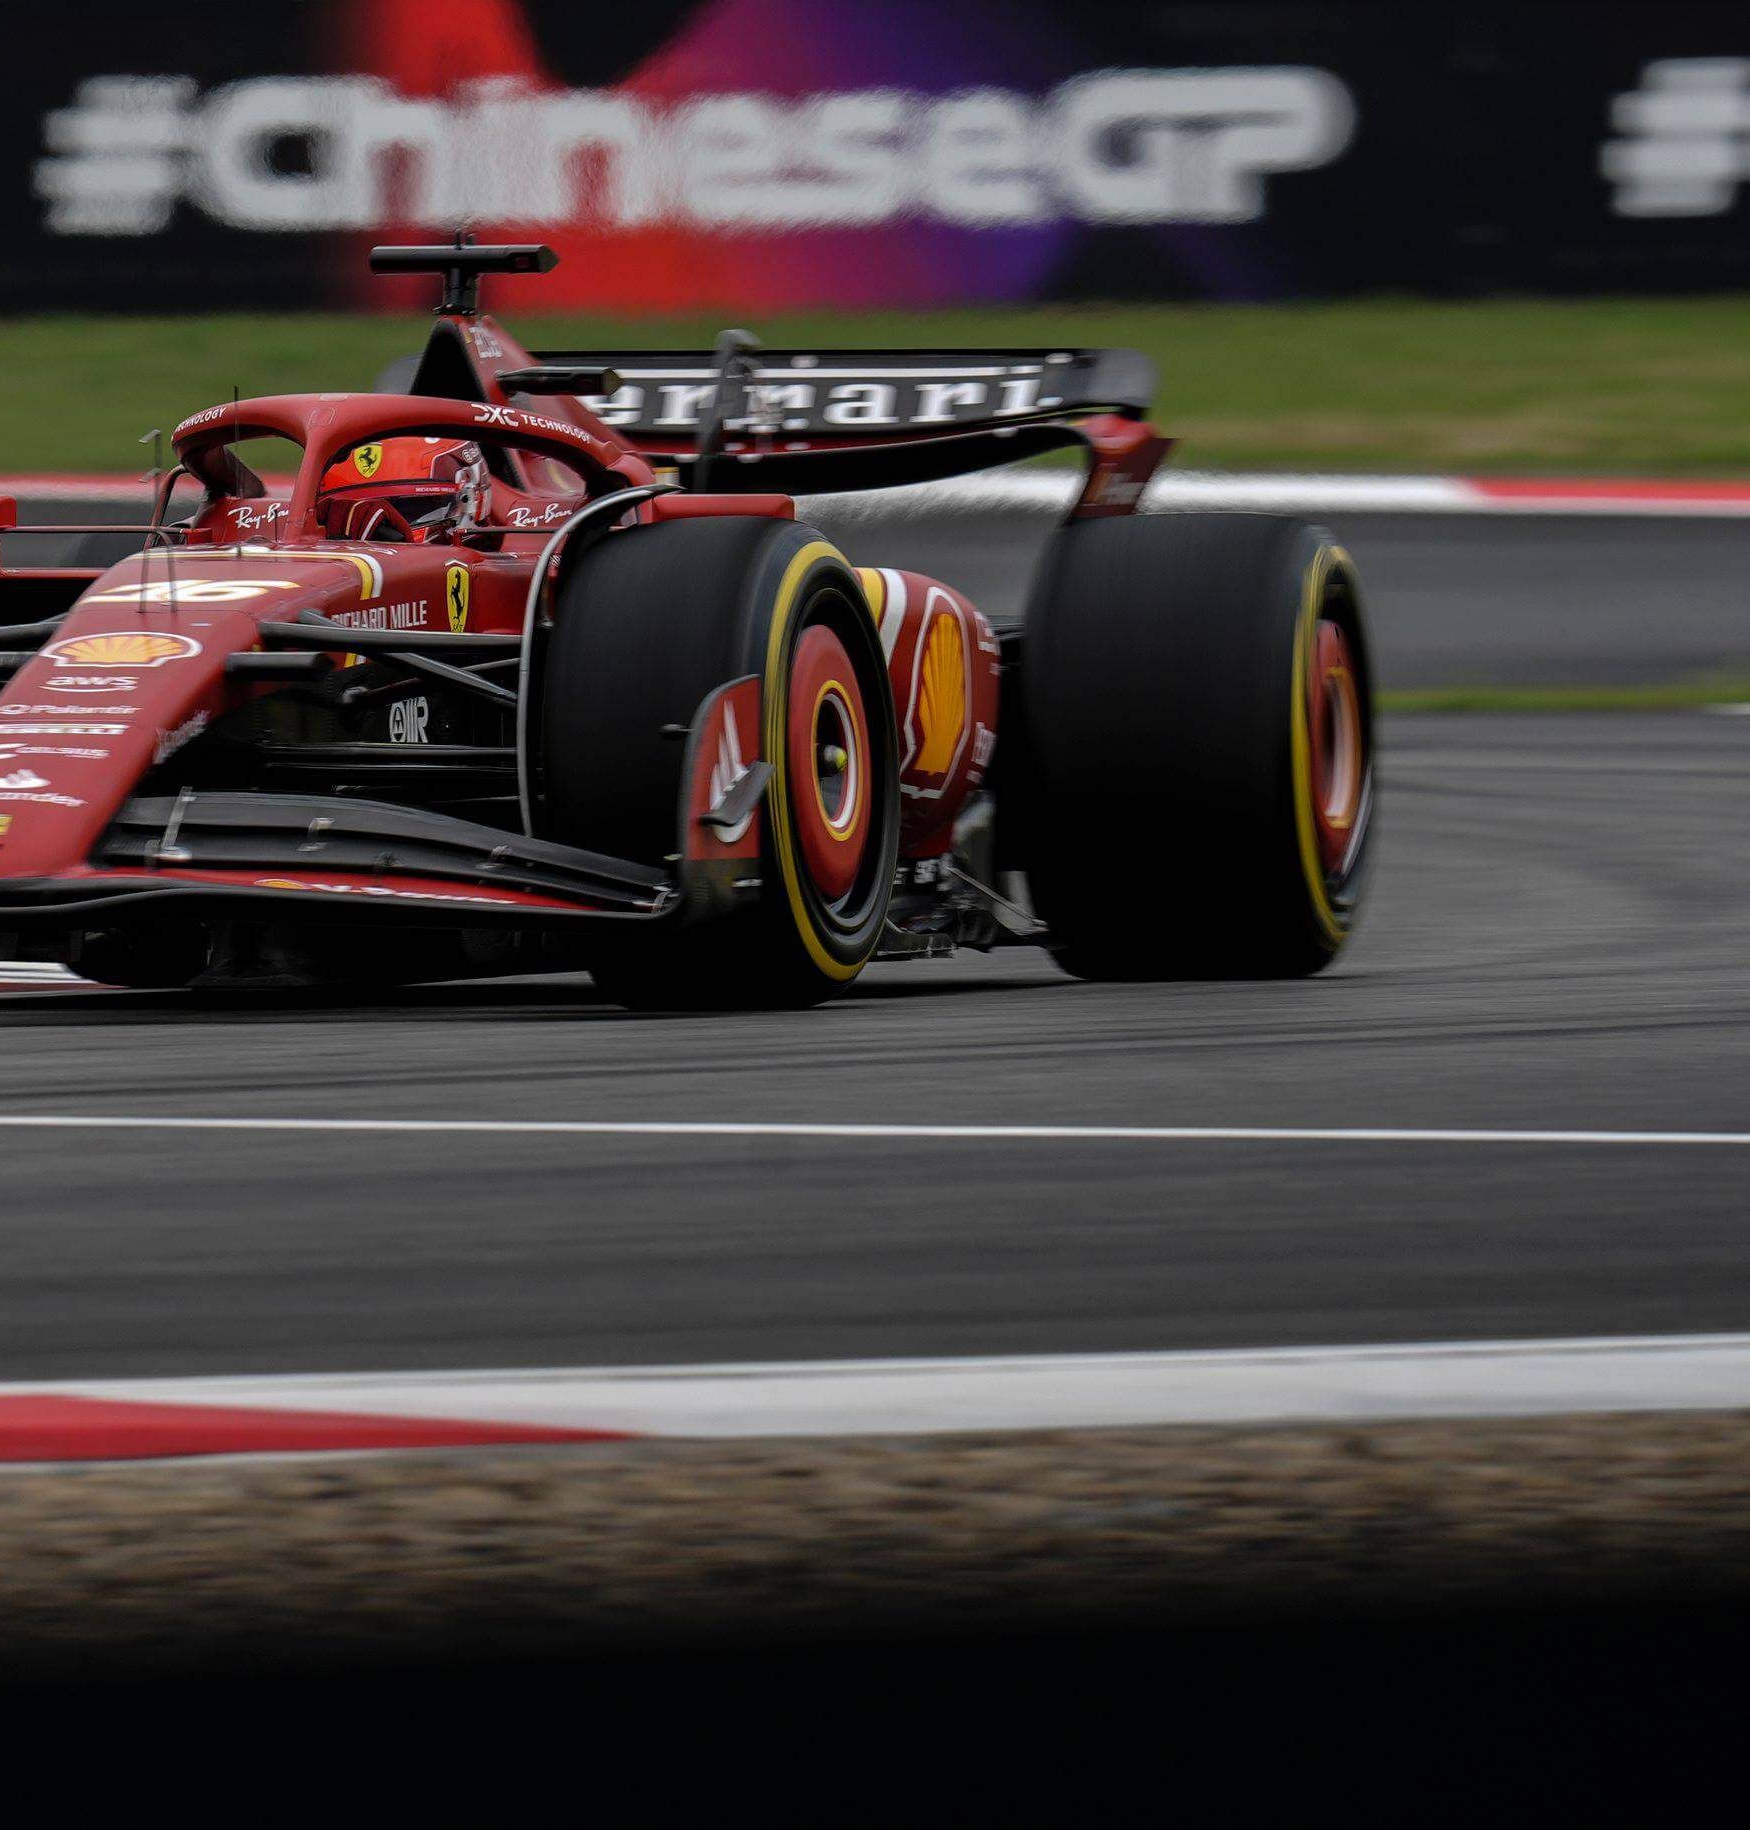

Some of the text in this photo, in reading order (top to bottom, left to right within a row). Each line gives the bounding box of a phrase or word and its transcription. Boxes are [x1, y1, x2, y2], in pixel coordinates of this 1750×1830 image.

[35, 66, 1357, 236] #ChineseGP
[586, 366, 1043, 428] errari
[470, 403, 591, 444] DXC TECHNOLOGY
[507, 503, 573, 527] Ray-Ban
[390, 600, 428, 630] MILLE
